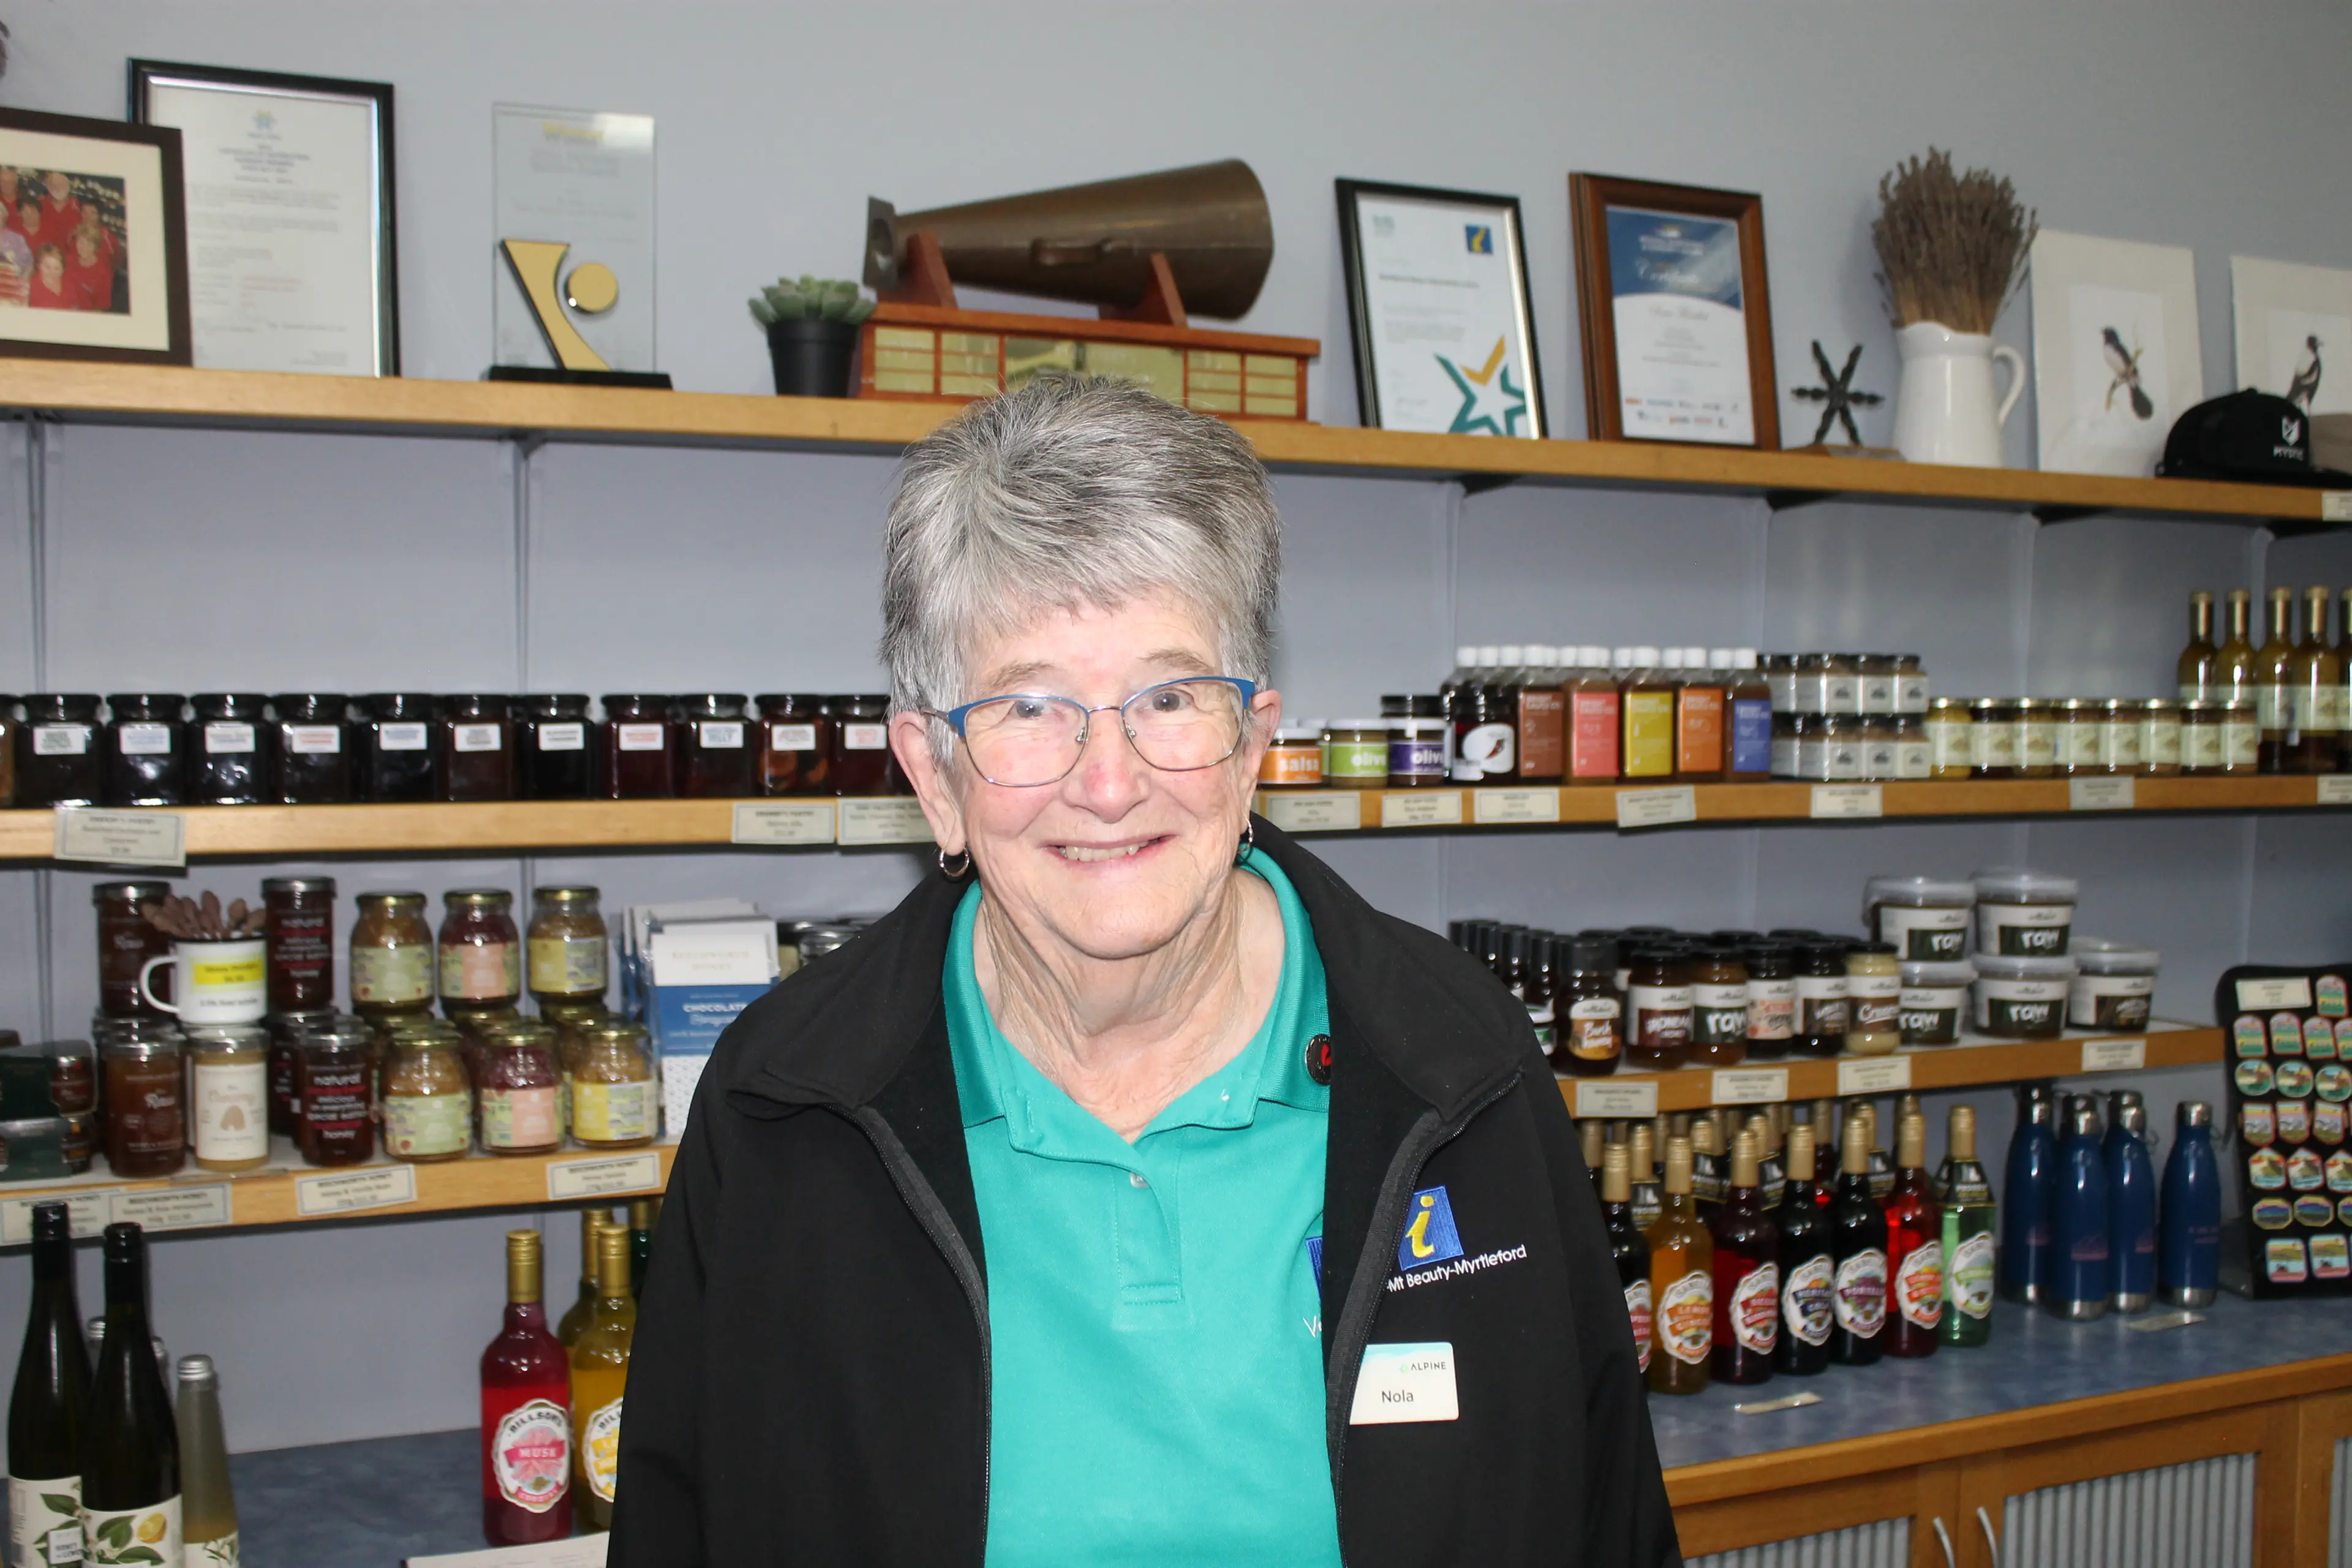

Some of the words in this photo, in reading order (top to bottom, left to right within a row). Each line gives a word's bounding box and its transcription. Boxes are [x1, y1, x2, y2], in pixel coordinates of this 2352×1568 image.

[1278, 756, 1320, 772] salsa
[2021, 929, 2060, 949] raw
[1899, 1012, 1939, 1031] raw
[2009, 1003, 2050, 1023] raw
[1406, 1244, 1528, 1288] Beauty-Myrtleford
[1411, 1361, 1446, 1371] ALPINE
[1382, 1389, 1414, 1403] Nola
[519, 1447, 557, 1458] MUSK
